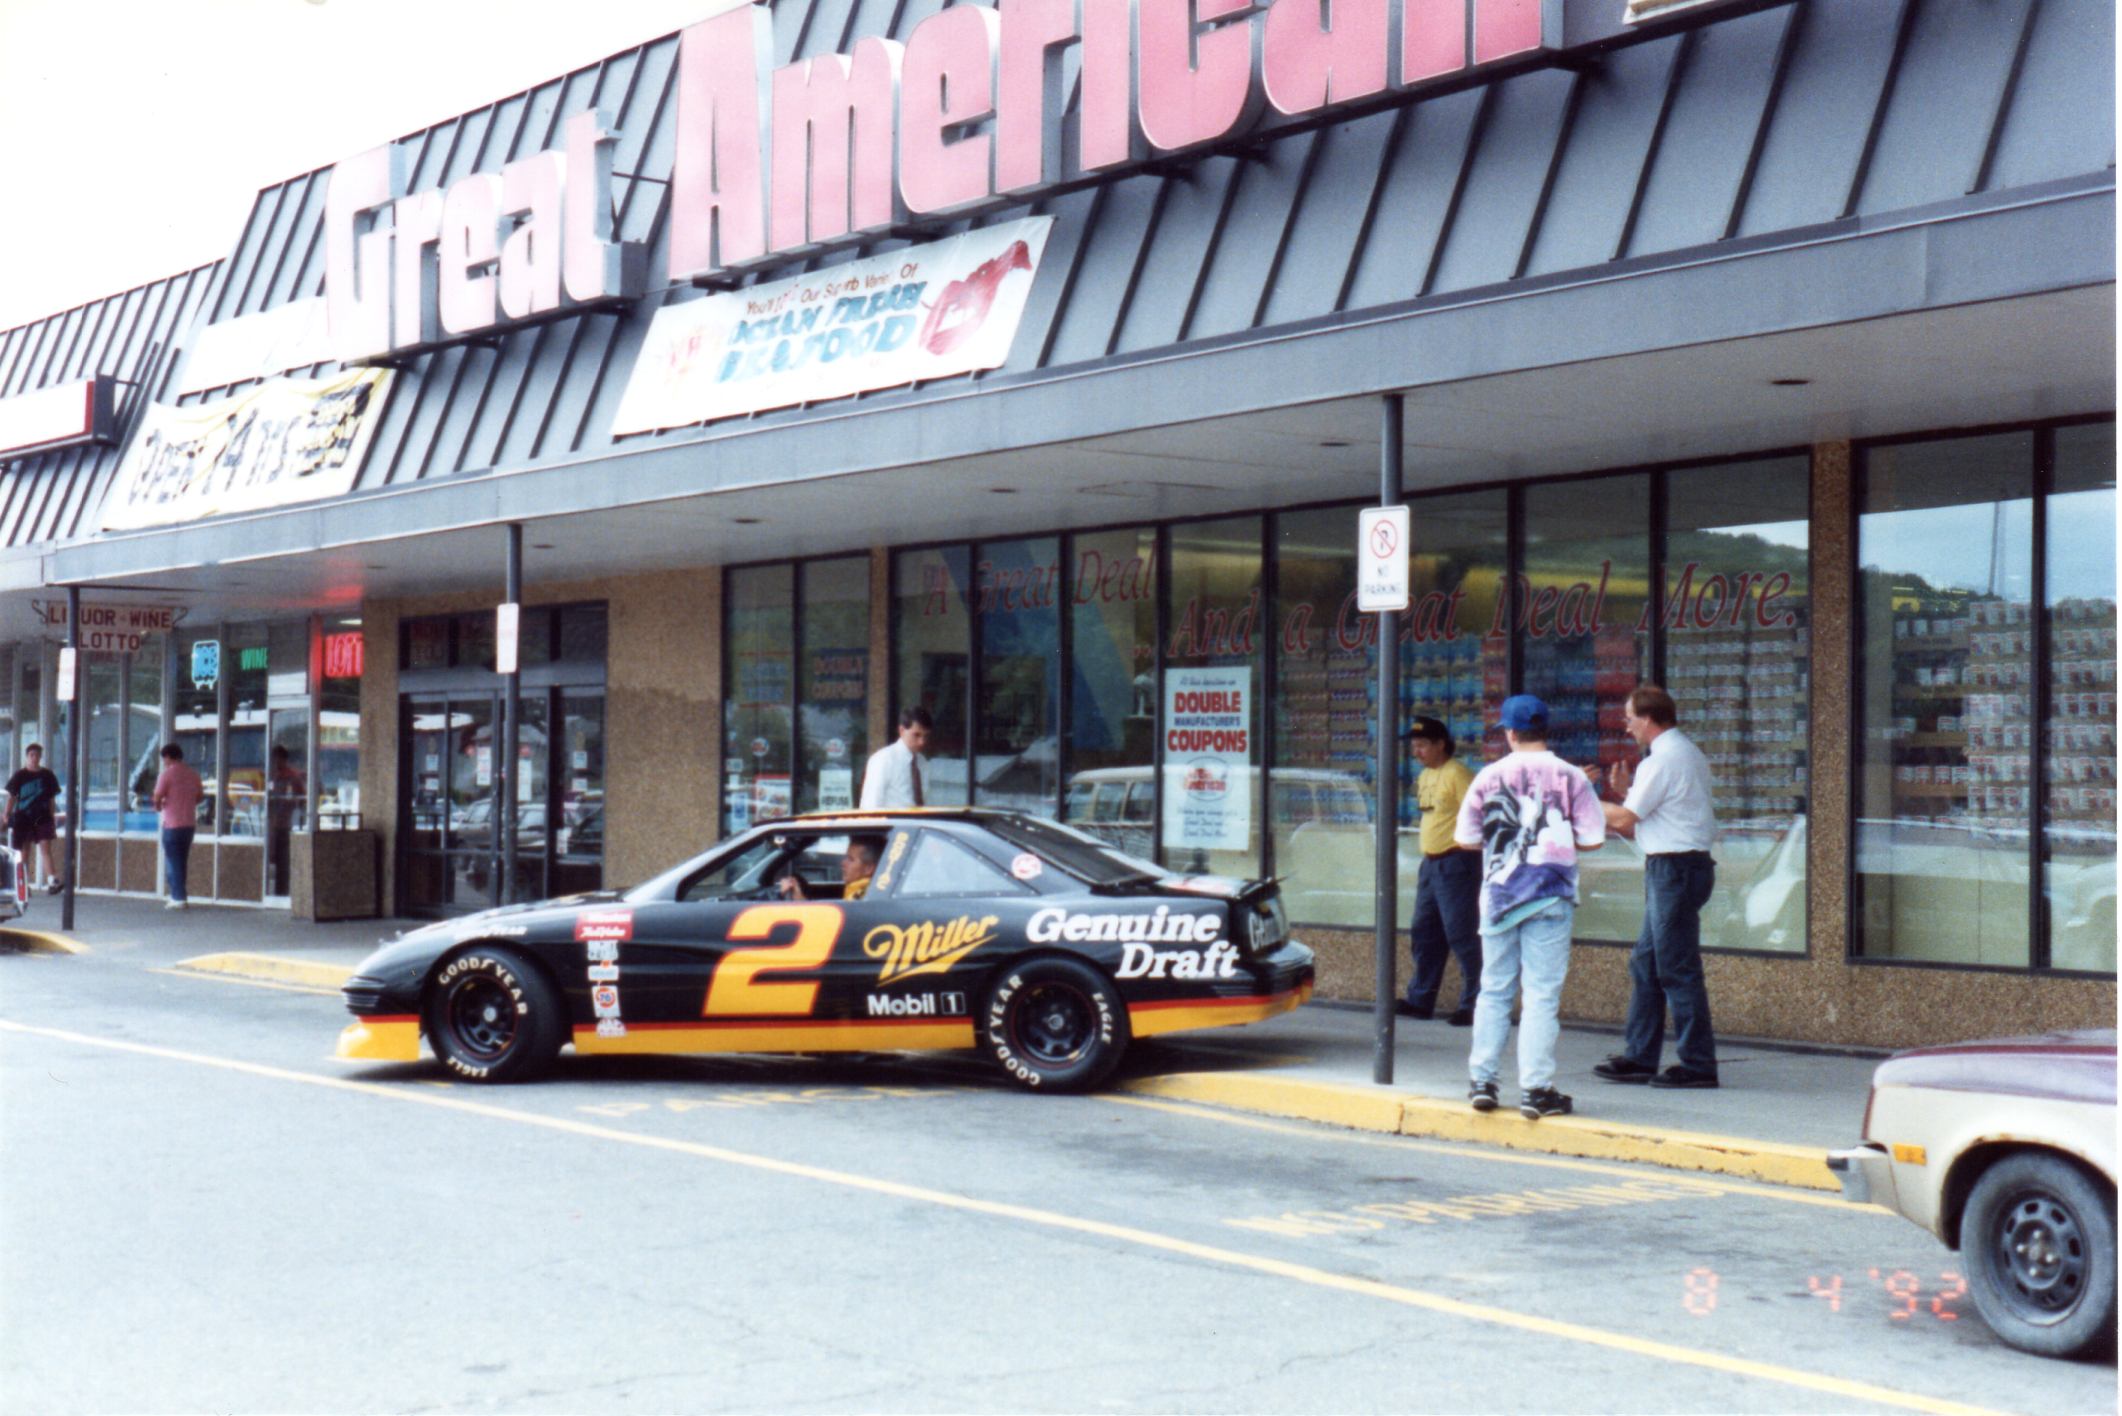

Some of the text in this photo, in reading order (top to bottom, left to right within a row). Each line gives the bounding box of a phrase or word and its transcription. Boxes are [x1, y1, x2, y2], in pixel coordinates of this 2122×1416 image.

[325, 107, 612, 362] Great
[800, 287, 820, 304] Our
[900, 262, 919, 279] Of
[1072, 541, 1157, 605] Deal
[50, 607, 172, 628] LIUOR WINE
[1167, 559, 1798, 658] And a Gat Deal More.
[79, 631, 141, 651] LOTTO
[1174, 690, 1241, 714] DOUBLE
[1167, 729, 1248, 753] COUPONS
[1026, 905, 1222, 943] Genuine
[702, 903, 845, 1017] 2
[863, 914, 999, 981] Miller
[1114, 939, 1240, 980] Draft
[867, 993, 936, 1015] Mobil
[1092, 992, 1113, 1044] EAGLE
[447, 1055, 489, 1077] EAGLE
